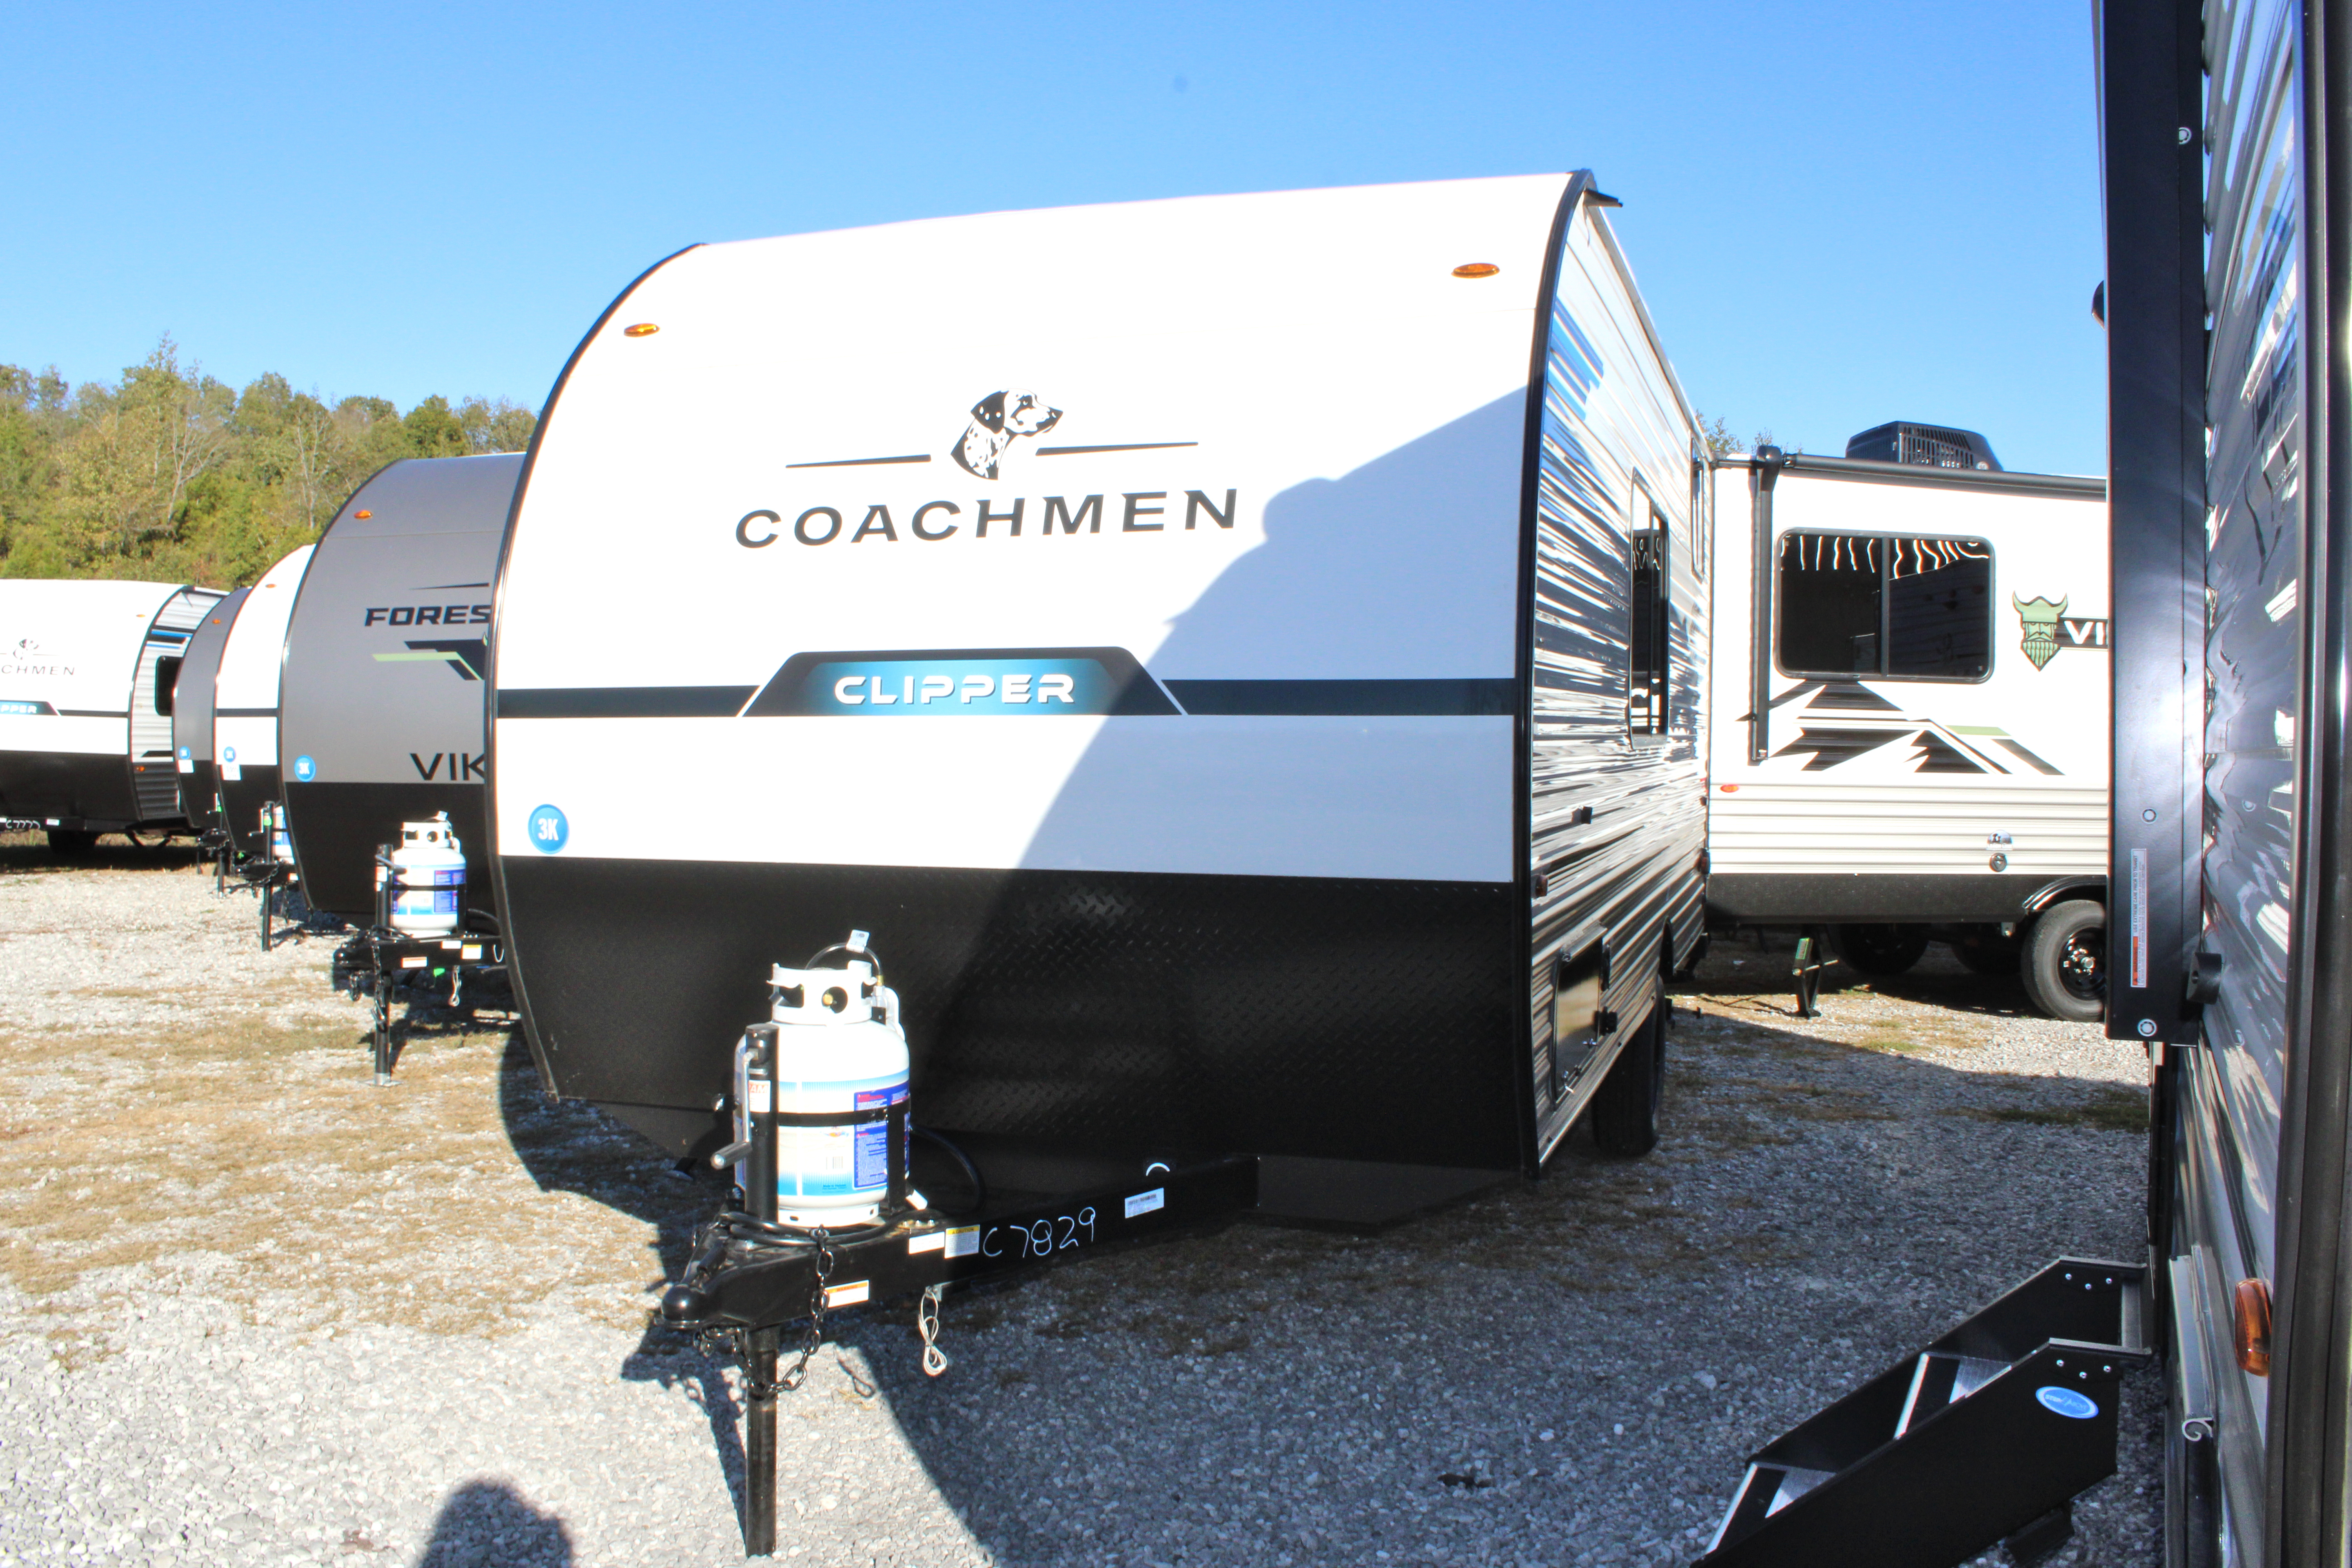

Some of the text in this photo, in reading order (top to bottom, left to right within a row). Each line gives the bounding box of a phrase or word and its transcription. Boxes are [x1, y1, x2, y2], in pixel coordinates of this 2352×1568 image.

[735, 488, 1237, 548] COACHMEN
[365, 605, 492, 626] FORES
[2063, 620, 2108, 645] VI
[1, 664, 74, 675] CHMEN
[833, 674, 1075, 704] CLIPPER
[299, 762, 310, 775] 3K
[410, 753, 485, 780] VIK
[537, 817, 559, 841] 3K
[983, 1207, 1096, 1258] C7829
